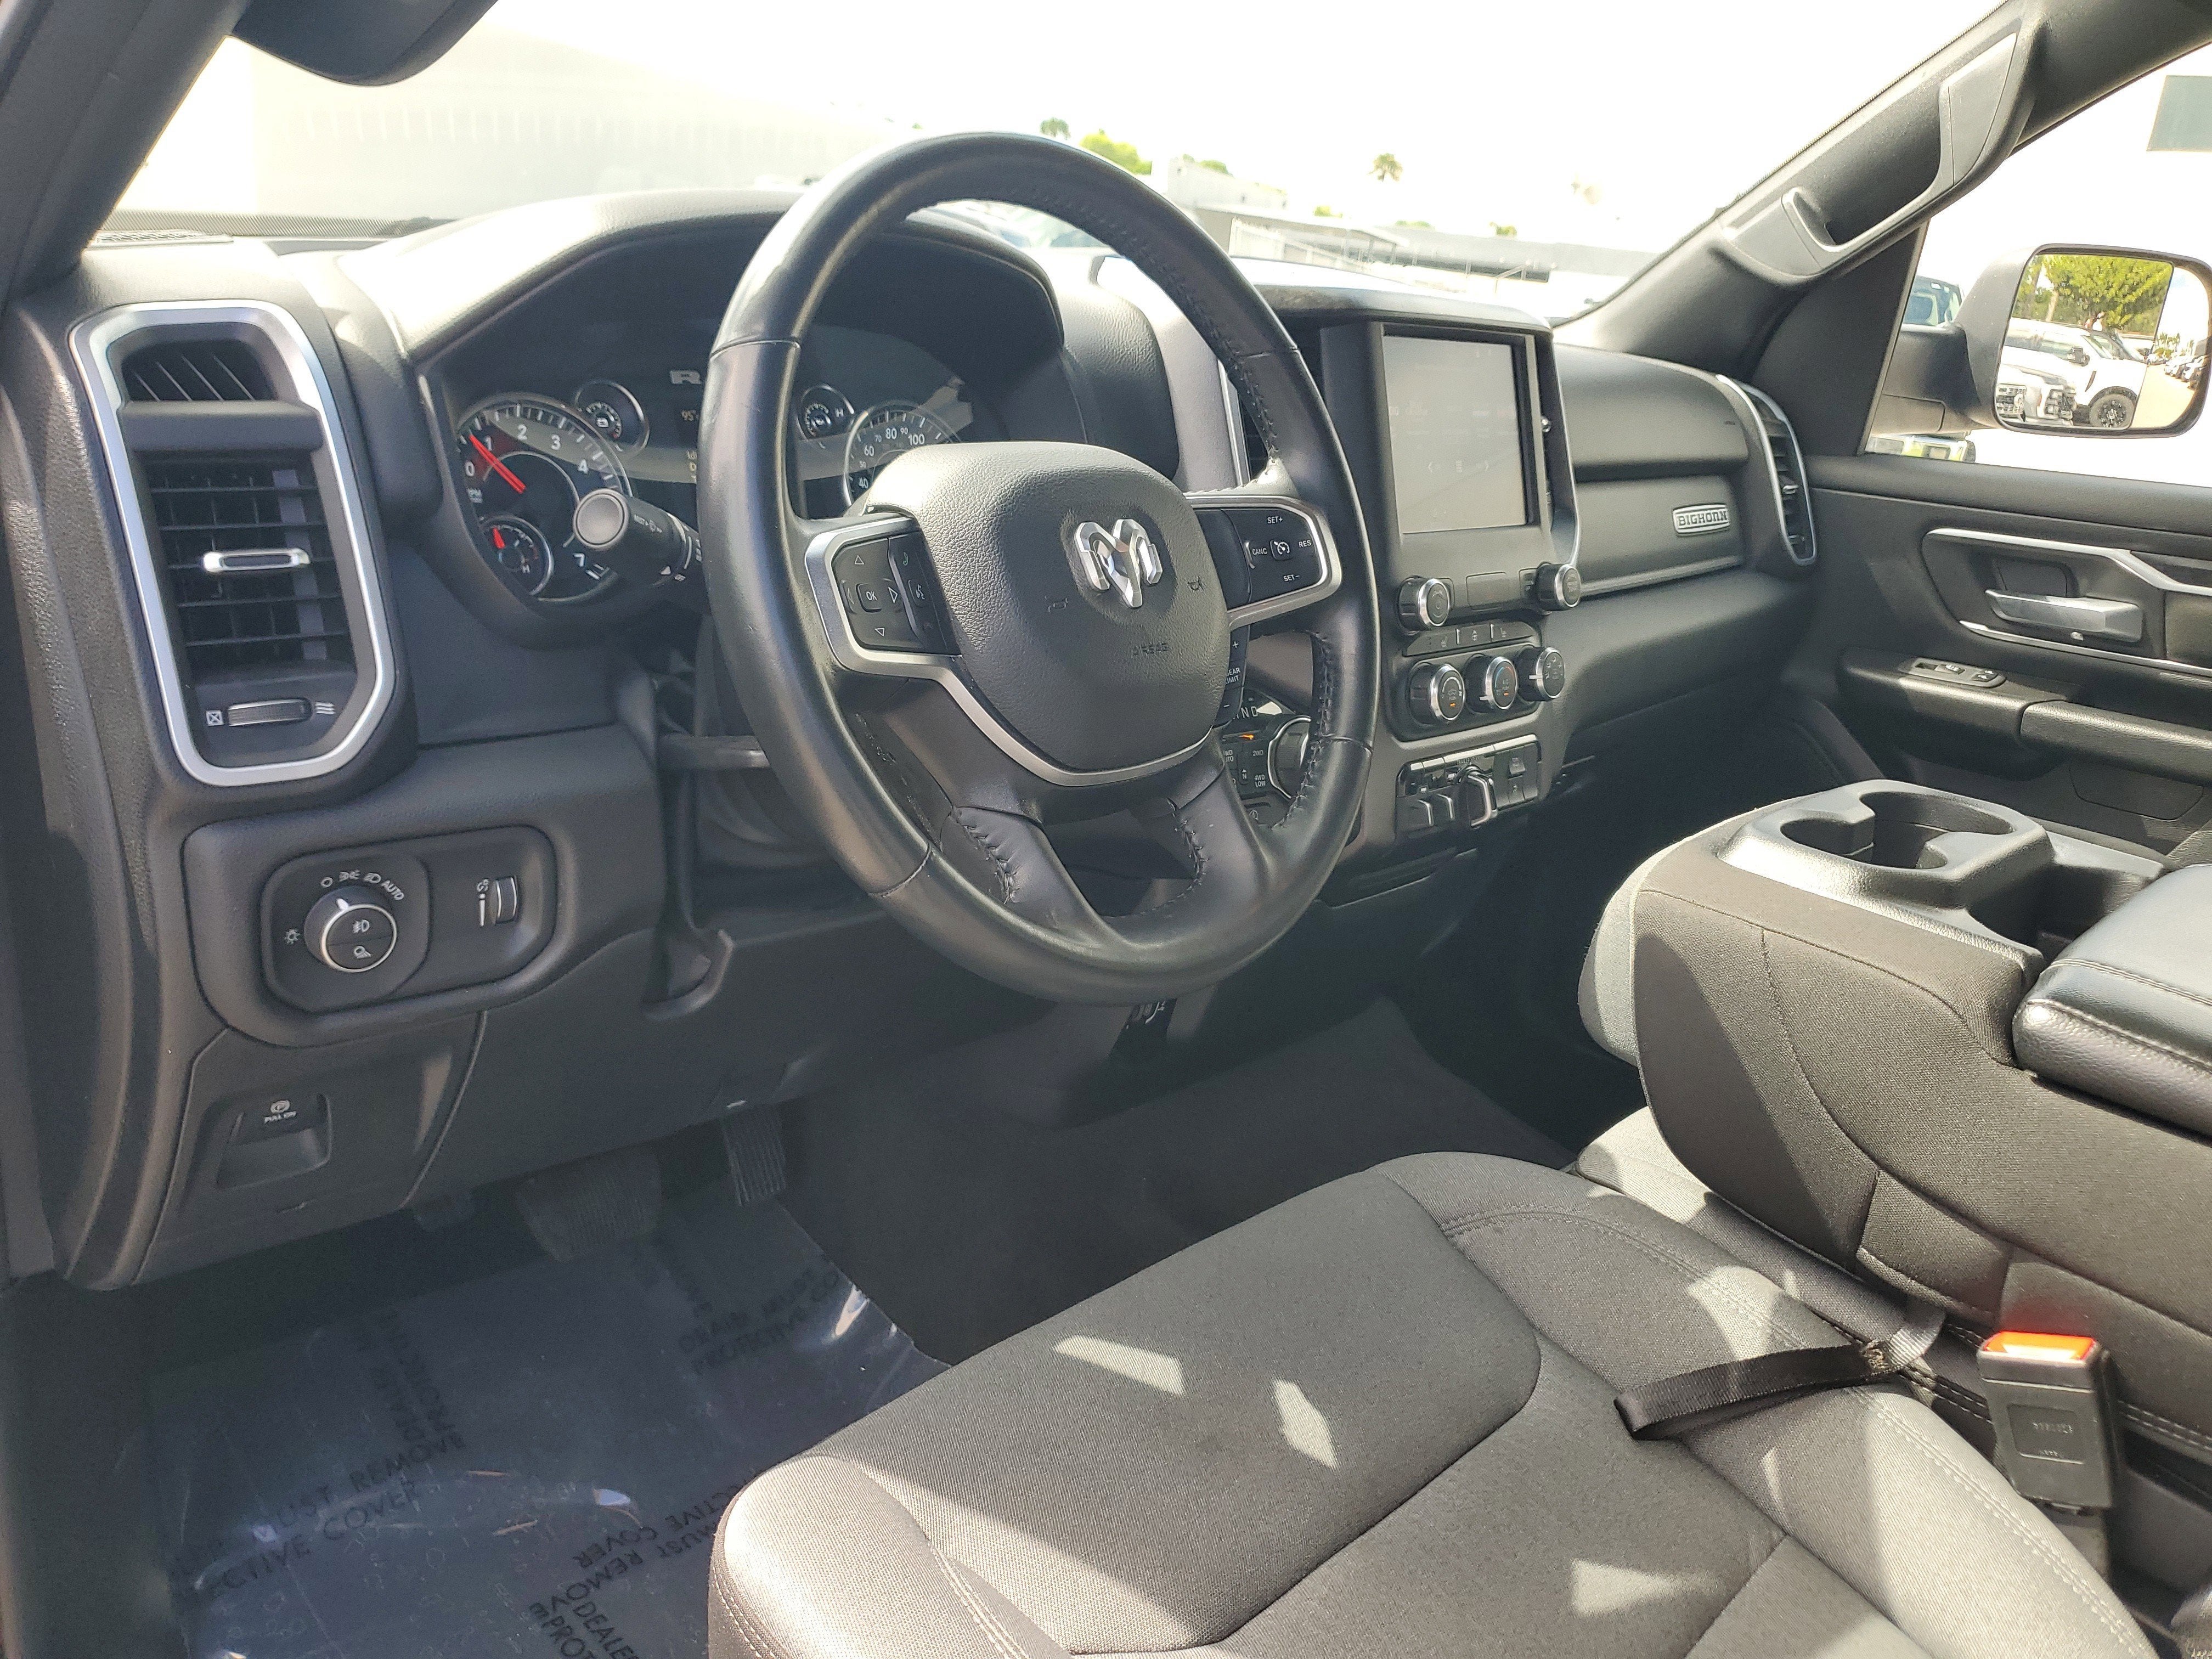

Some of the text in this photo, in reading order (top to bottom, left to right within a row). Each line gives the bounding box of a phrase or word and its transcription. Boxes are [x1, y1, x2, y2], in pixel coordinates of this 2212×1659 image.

[518, 424, 527, 440] 2
[885, 427, 898, 439] 80
[908, 433, 925, 445] 100
[486, 436, 492, 451] 1
[551, 435, 561, 450] 3
[864, 445, 874, 456] 60
[465, 461, 475, 477] 0
[578, 459, 589, 475] 4
[859, 477, 869, 489] 40
[866, 591, 877, 601] OK
[1227, 667, 1240, 676] EAR
[1226, 675, 1239, 684] IMIT
[381, 879, 404, 900] AUTO
[573, 1526, 658, 1568] COVER
[528, 1550, 644, 1620] REMOVE
